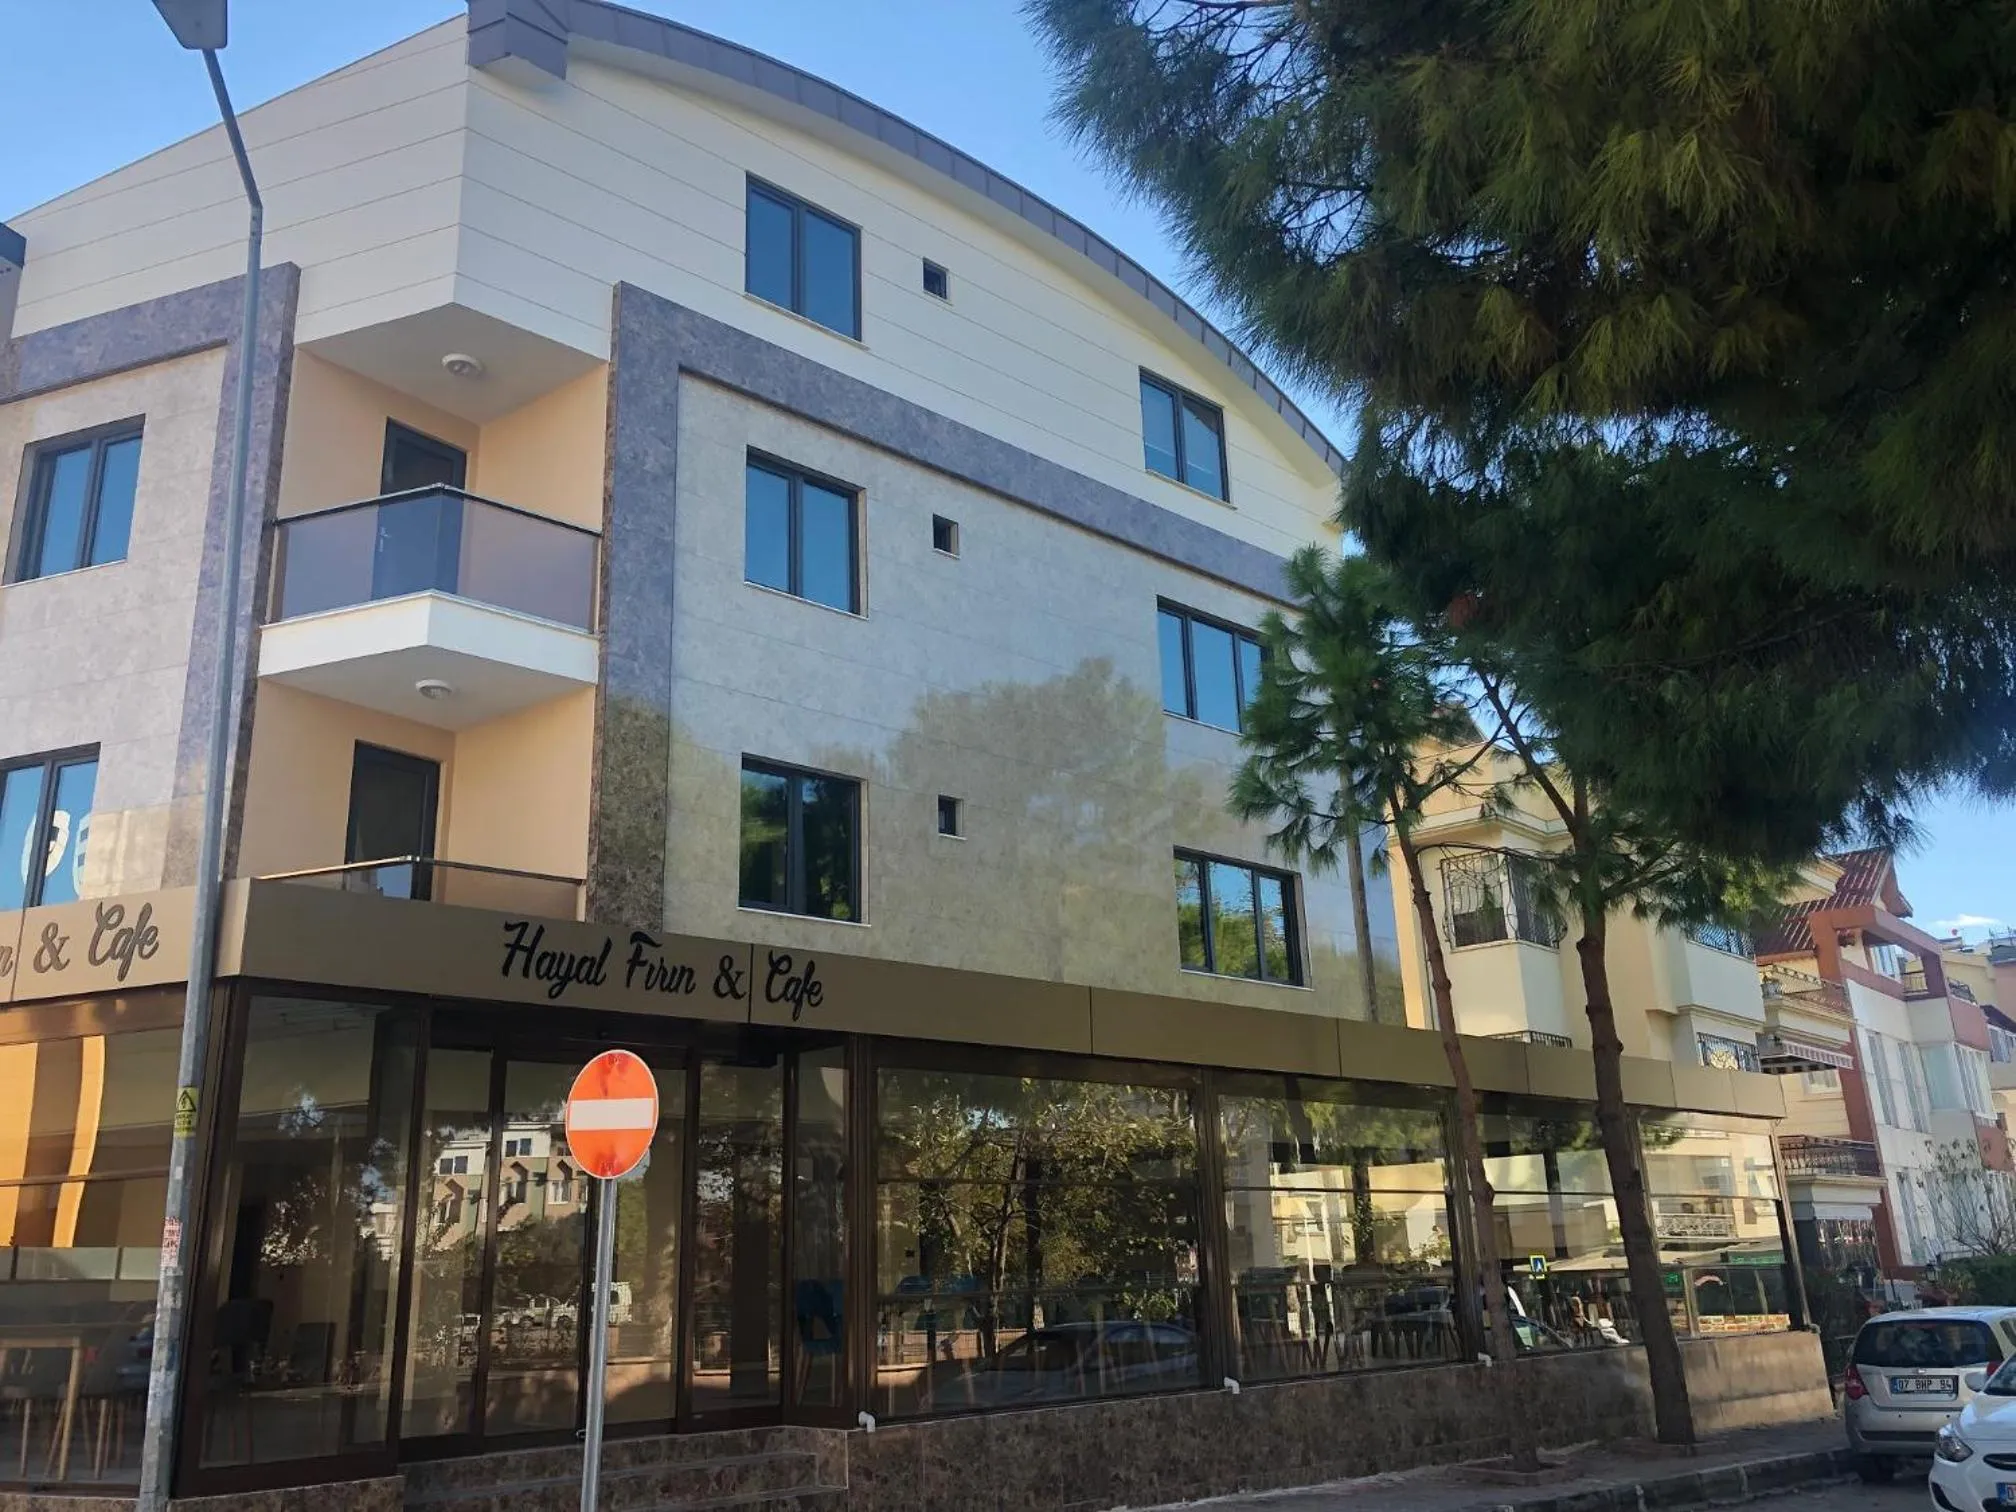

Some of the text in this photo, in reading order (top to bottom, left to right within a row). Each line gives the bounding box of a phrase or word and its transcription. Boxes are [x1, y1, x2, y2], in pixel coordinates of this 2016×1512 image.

[33, 921, 71, 974] &
[88, 901, 160, 982] Cafe
[502, 920, 613, 999] Hayal
[713, 954, 747, 1000] &
[765, 949, 824, 1022] Cafe
[1898, 1379, 1909, 1390] 07
